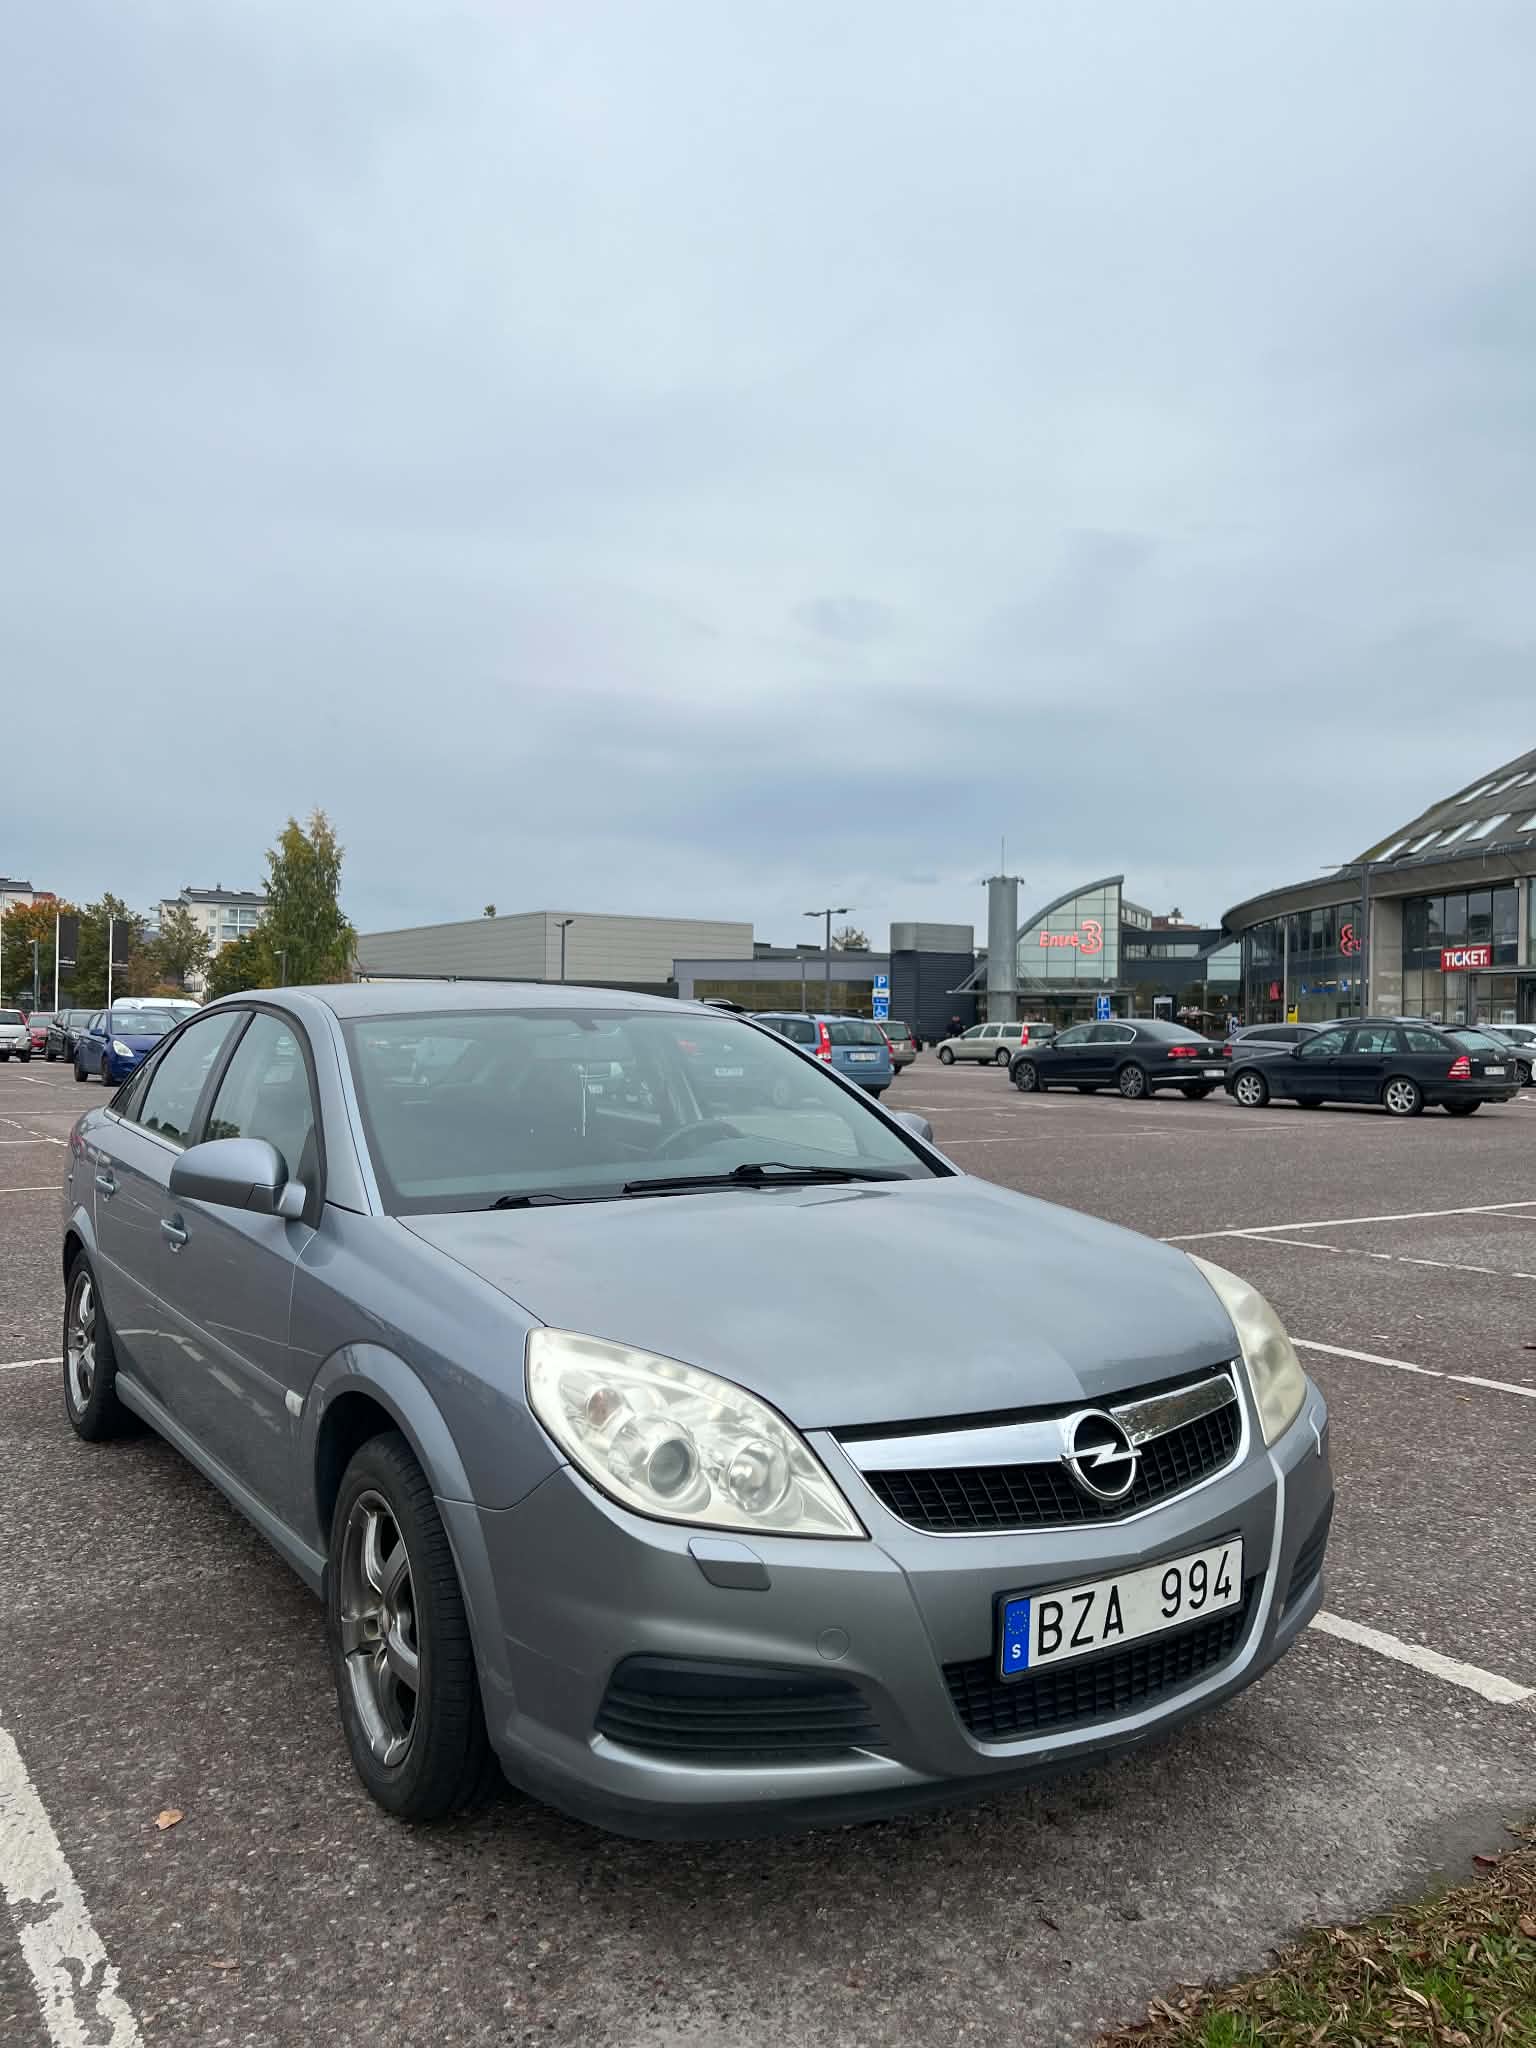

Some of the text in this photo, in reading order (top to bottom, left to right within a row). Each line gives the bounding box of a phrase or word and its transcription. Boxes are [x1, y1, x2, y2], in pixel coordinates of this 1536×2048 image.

[1039, 919, 1104, 955] Entré 3
[1444, 949, 1486, 967] TICKET
[878, 976, 886, 987] P
[1037, 1550, 1232, 1656] BZA 994
[1011, 1643, 1021, 1659] S
